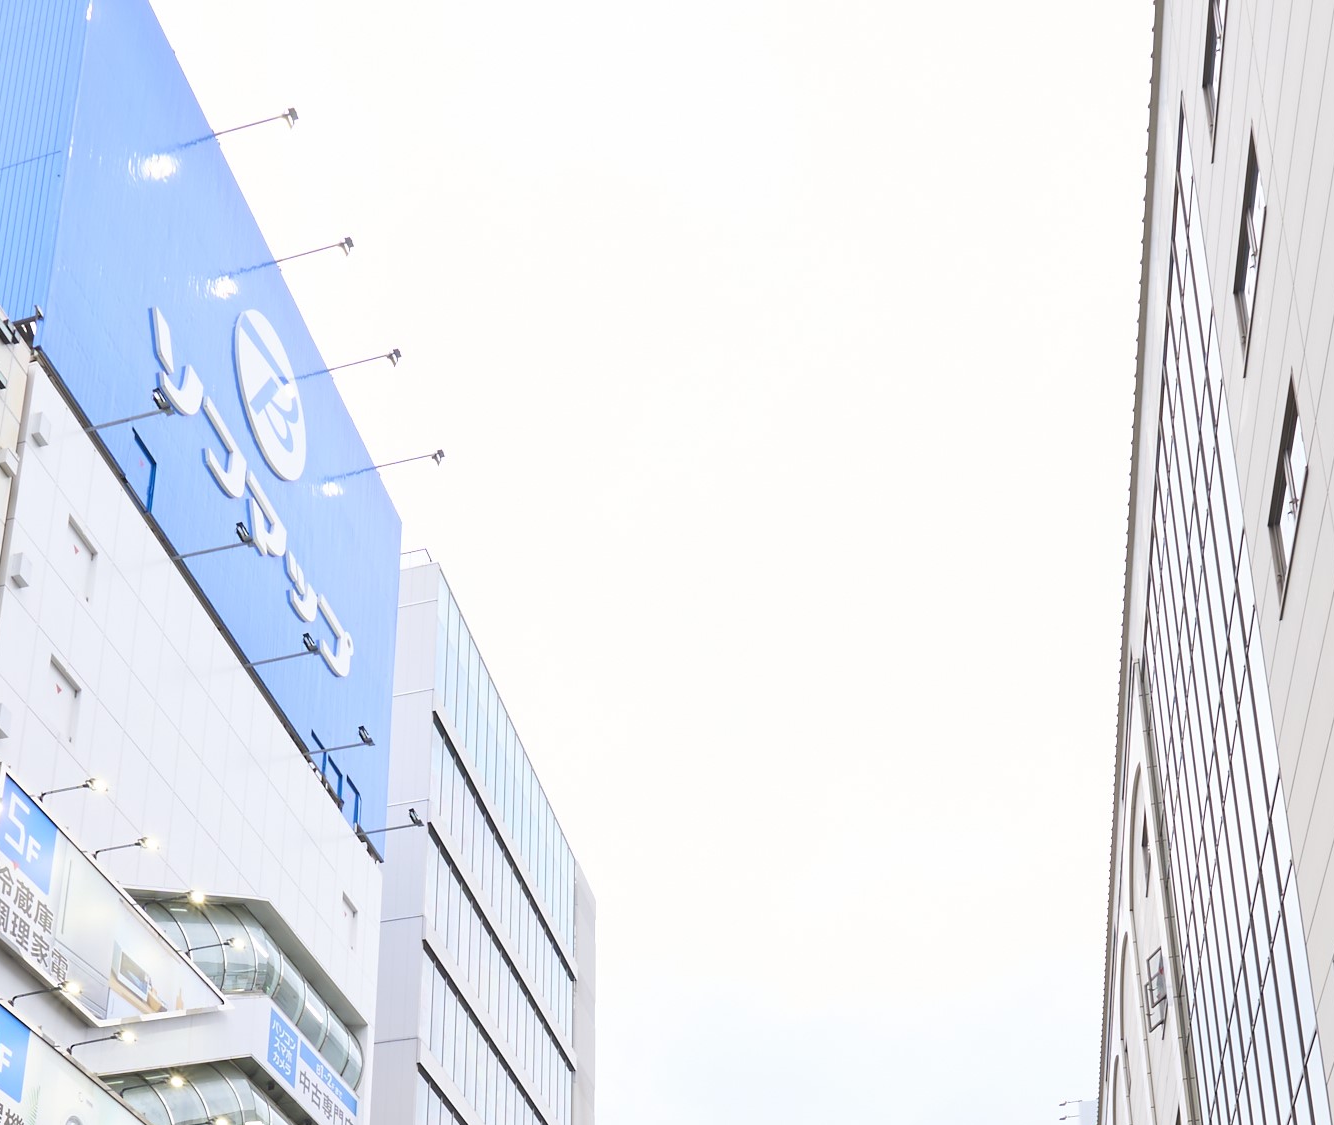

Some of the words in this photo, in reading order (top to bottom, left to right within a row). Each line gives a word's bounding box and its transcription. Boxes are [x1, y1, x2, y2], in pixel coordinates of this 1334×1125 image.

[2, 786, 43, 868] 5F
[271, 1018, 297, 1051] パソコン
[272, 1051, 292, 1077] カメラ
[273, 1036, 293, 1064] スマホ
